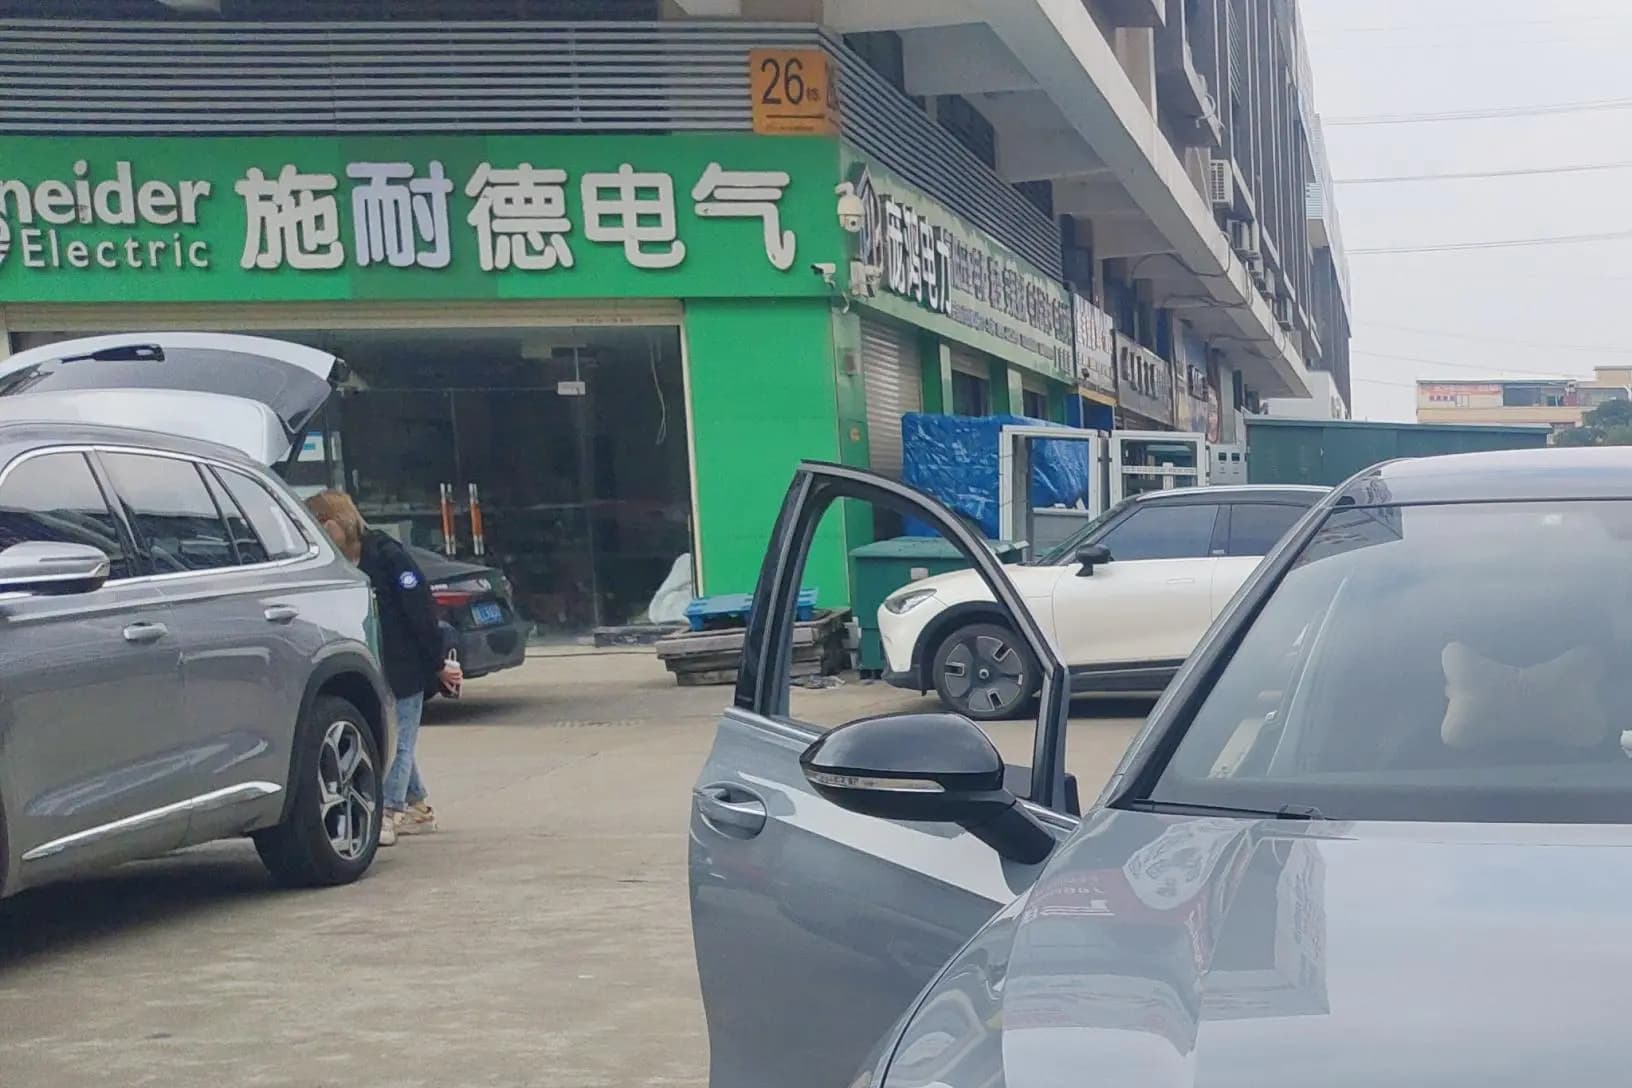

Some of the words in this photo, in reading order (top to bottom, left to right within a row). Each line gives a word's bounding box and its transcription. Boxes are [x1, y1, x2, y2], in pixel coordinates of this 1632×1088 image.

[20, 228, 209, 269] Electric
[234, 161, 797, 272] 施耐德电气
